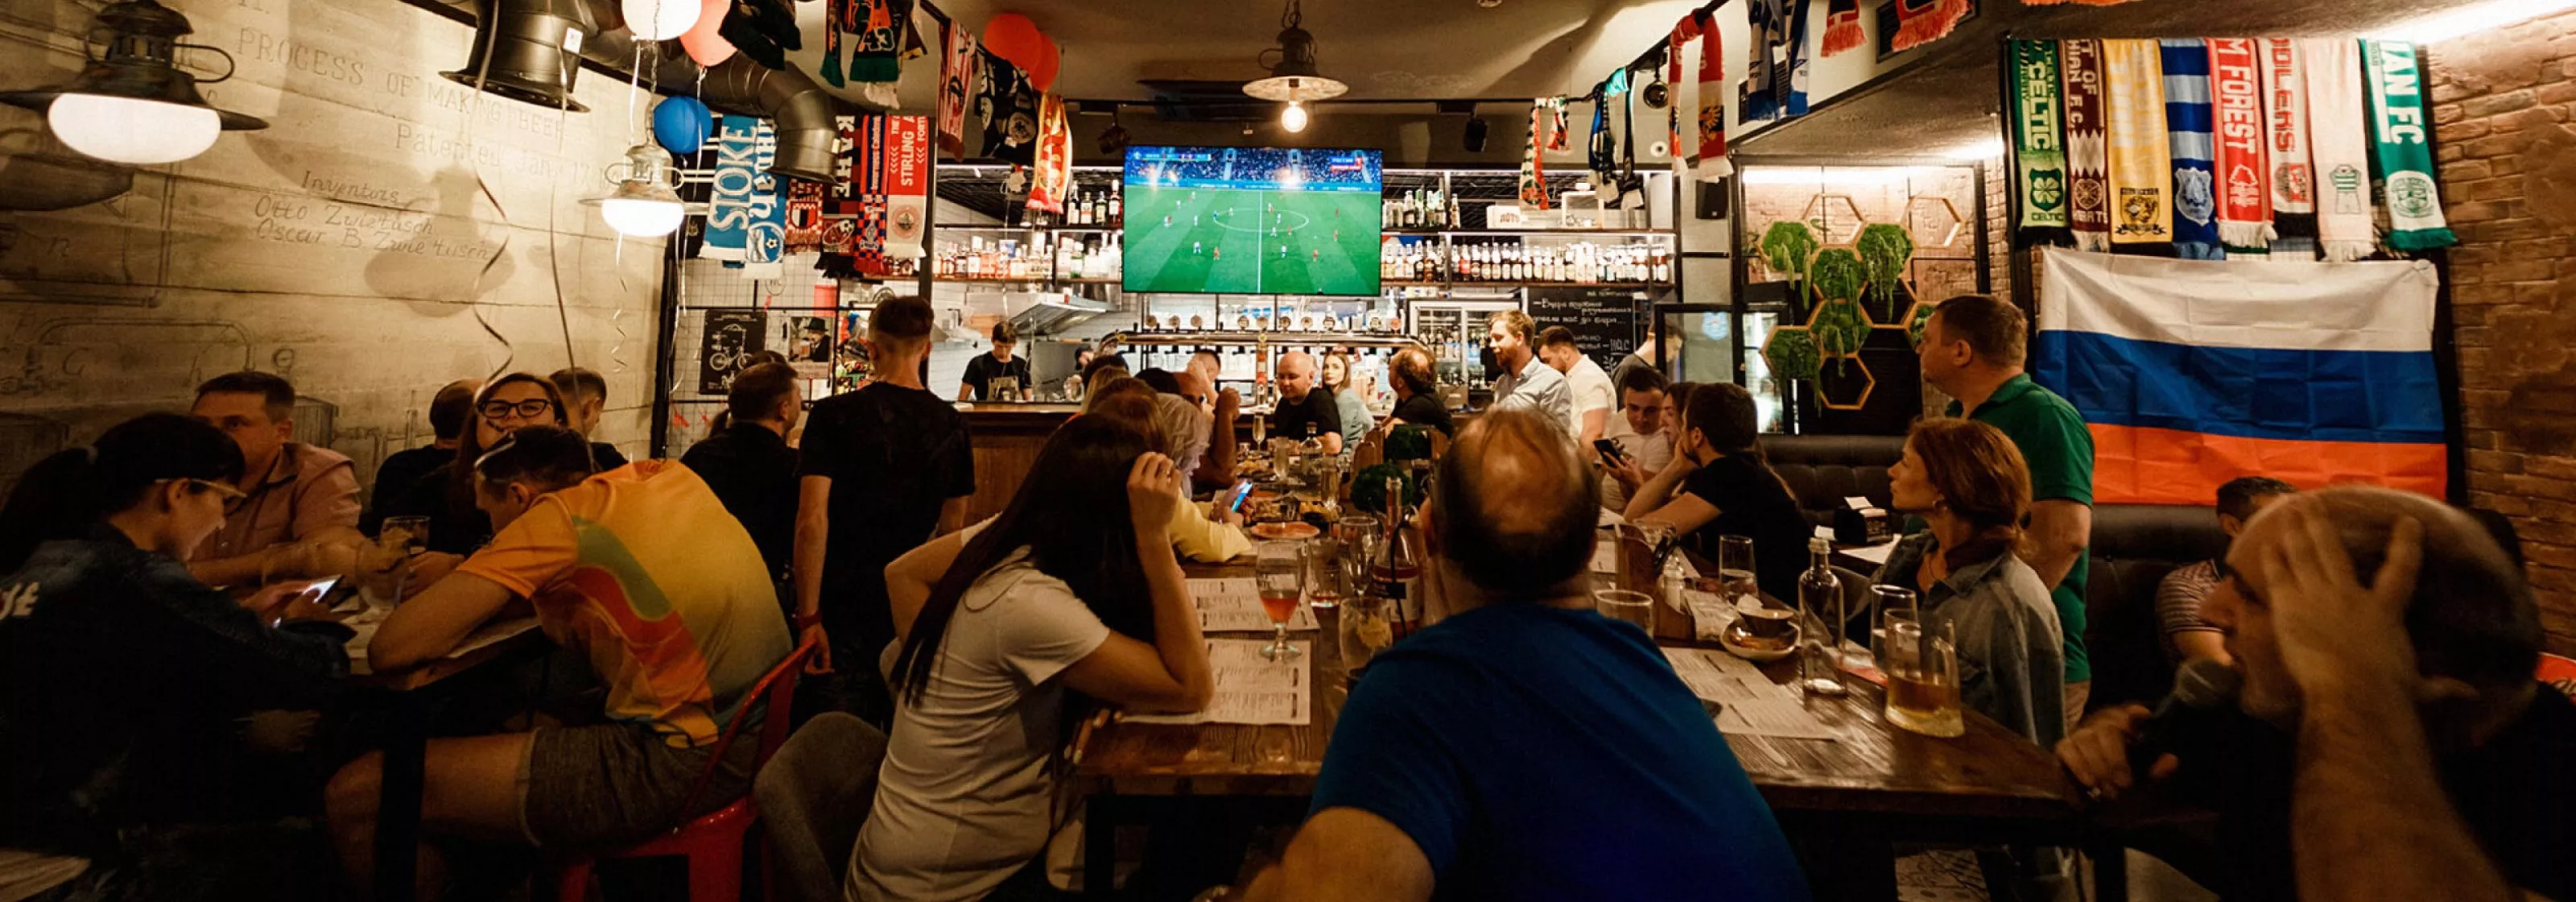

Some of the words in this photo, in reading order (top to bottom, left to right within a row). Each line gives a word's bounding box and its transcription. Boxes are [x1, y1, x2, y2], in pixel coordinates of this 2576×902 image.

[237, 27, 365, 86] PROCESS
[2083, 71, 2097, 95] OF
[2029, 61, 2052, 151] CELTIC
[2220, 66, 2256, 155] FOREST
[2388, 106, 2425, 145] FC
[395, 123, 501, 168] Patented
[900, 130, 914, 188] STIRLING
[707, 126, 758, 231] STOKE
[254, 196, 308, 221] Otto
[2031, 211, 2064, 222] CELTIC
[256, 220, 324, 244] Oscar
